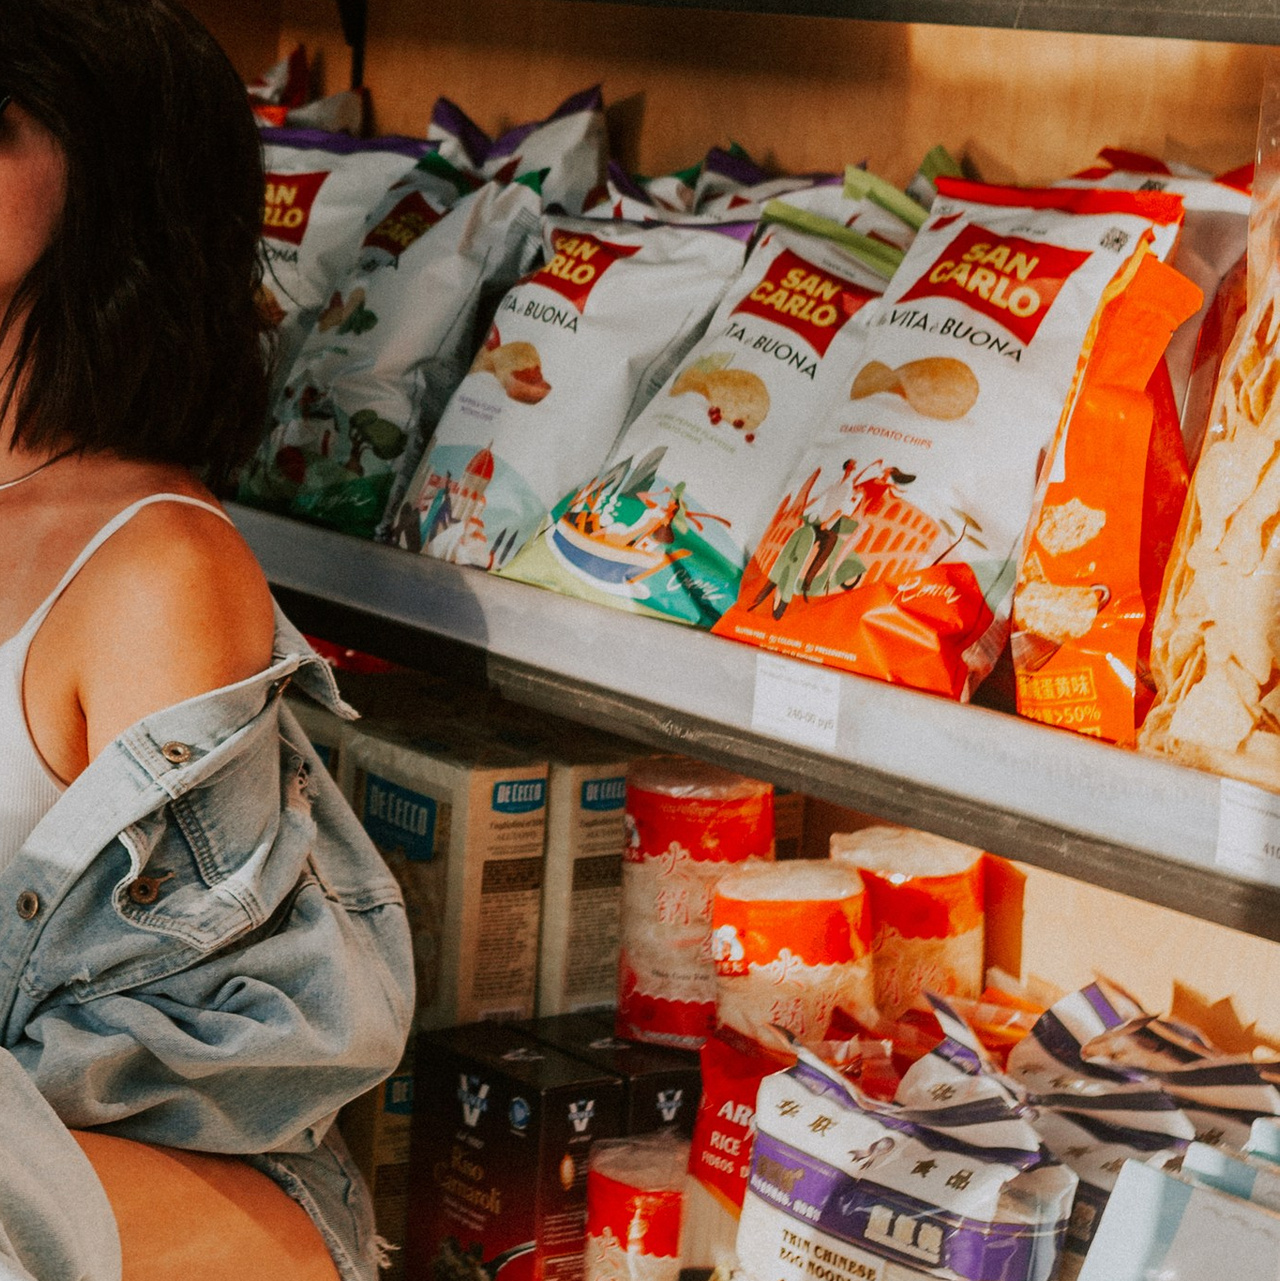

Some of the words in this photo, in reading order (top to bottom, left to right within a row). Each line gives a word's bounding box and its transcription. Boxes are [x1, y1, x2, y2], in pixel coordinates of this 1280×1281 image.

[264, 183, 298, 206] AN
[544, 254, 596, 284] RLO
[962, 243, 1040, 281] SAN
[780, 268, 842, 302] SAN
[929, 261, 1041, 318] CARLO
[524, 301, 579, 333] BUONA
[750, 281, 838, 327] CARLO
[889, 310, 929, 332] VITA
[940, 318, 1023, 363] BUONA
[752, 335, 818, 380] BUONA
[866, 425, 903, 441] POTATO
[903, 434, 933, 449] CHIPS
[710, 1131, 742, 1156] RICE
[783, 1229, 811, 1252] THIN
